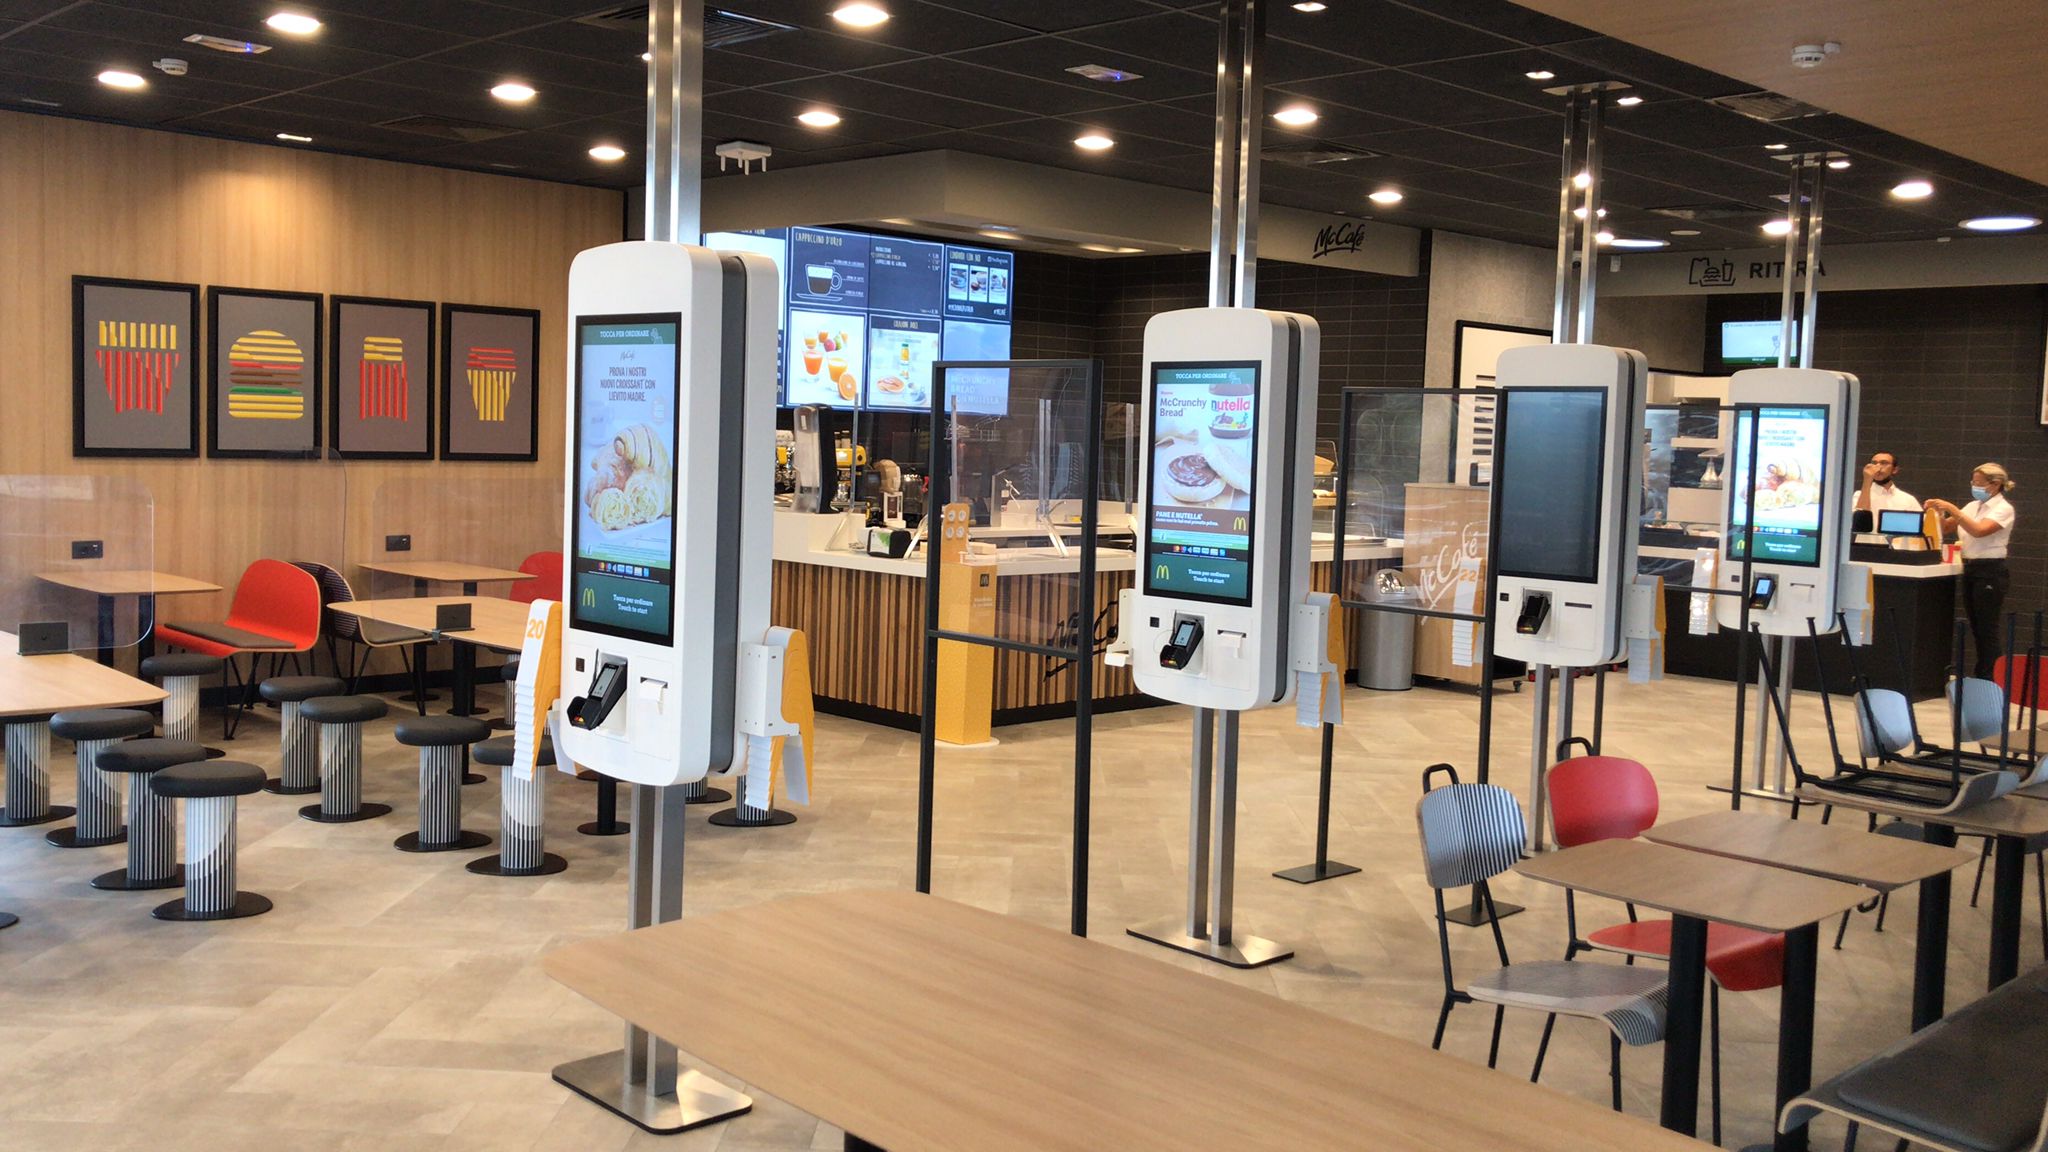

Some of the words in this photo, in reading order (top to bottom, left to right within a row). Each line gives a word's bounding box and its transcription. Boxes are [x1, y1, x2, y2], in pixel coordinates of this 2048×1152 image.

[1312, 222, 1365, 259] McCafé
[1750, 260, 1826, 278] RITRA
[600, 330, 616, 338] TOCCA
[608, 366, 625, 376] PROVA
[1160, 398, 1207, 409] McCrunchy
[1211, 398, 1251, 412] nutella
[1461, 568, 1477, 580] 22
[613, 594, 626, 602] Tocca
[635, 597, 653, 607] ordinare
[618, 603, 631, 611] Touch
[526, 618, 544, 640] 20
